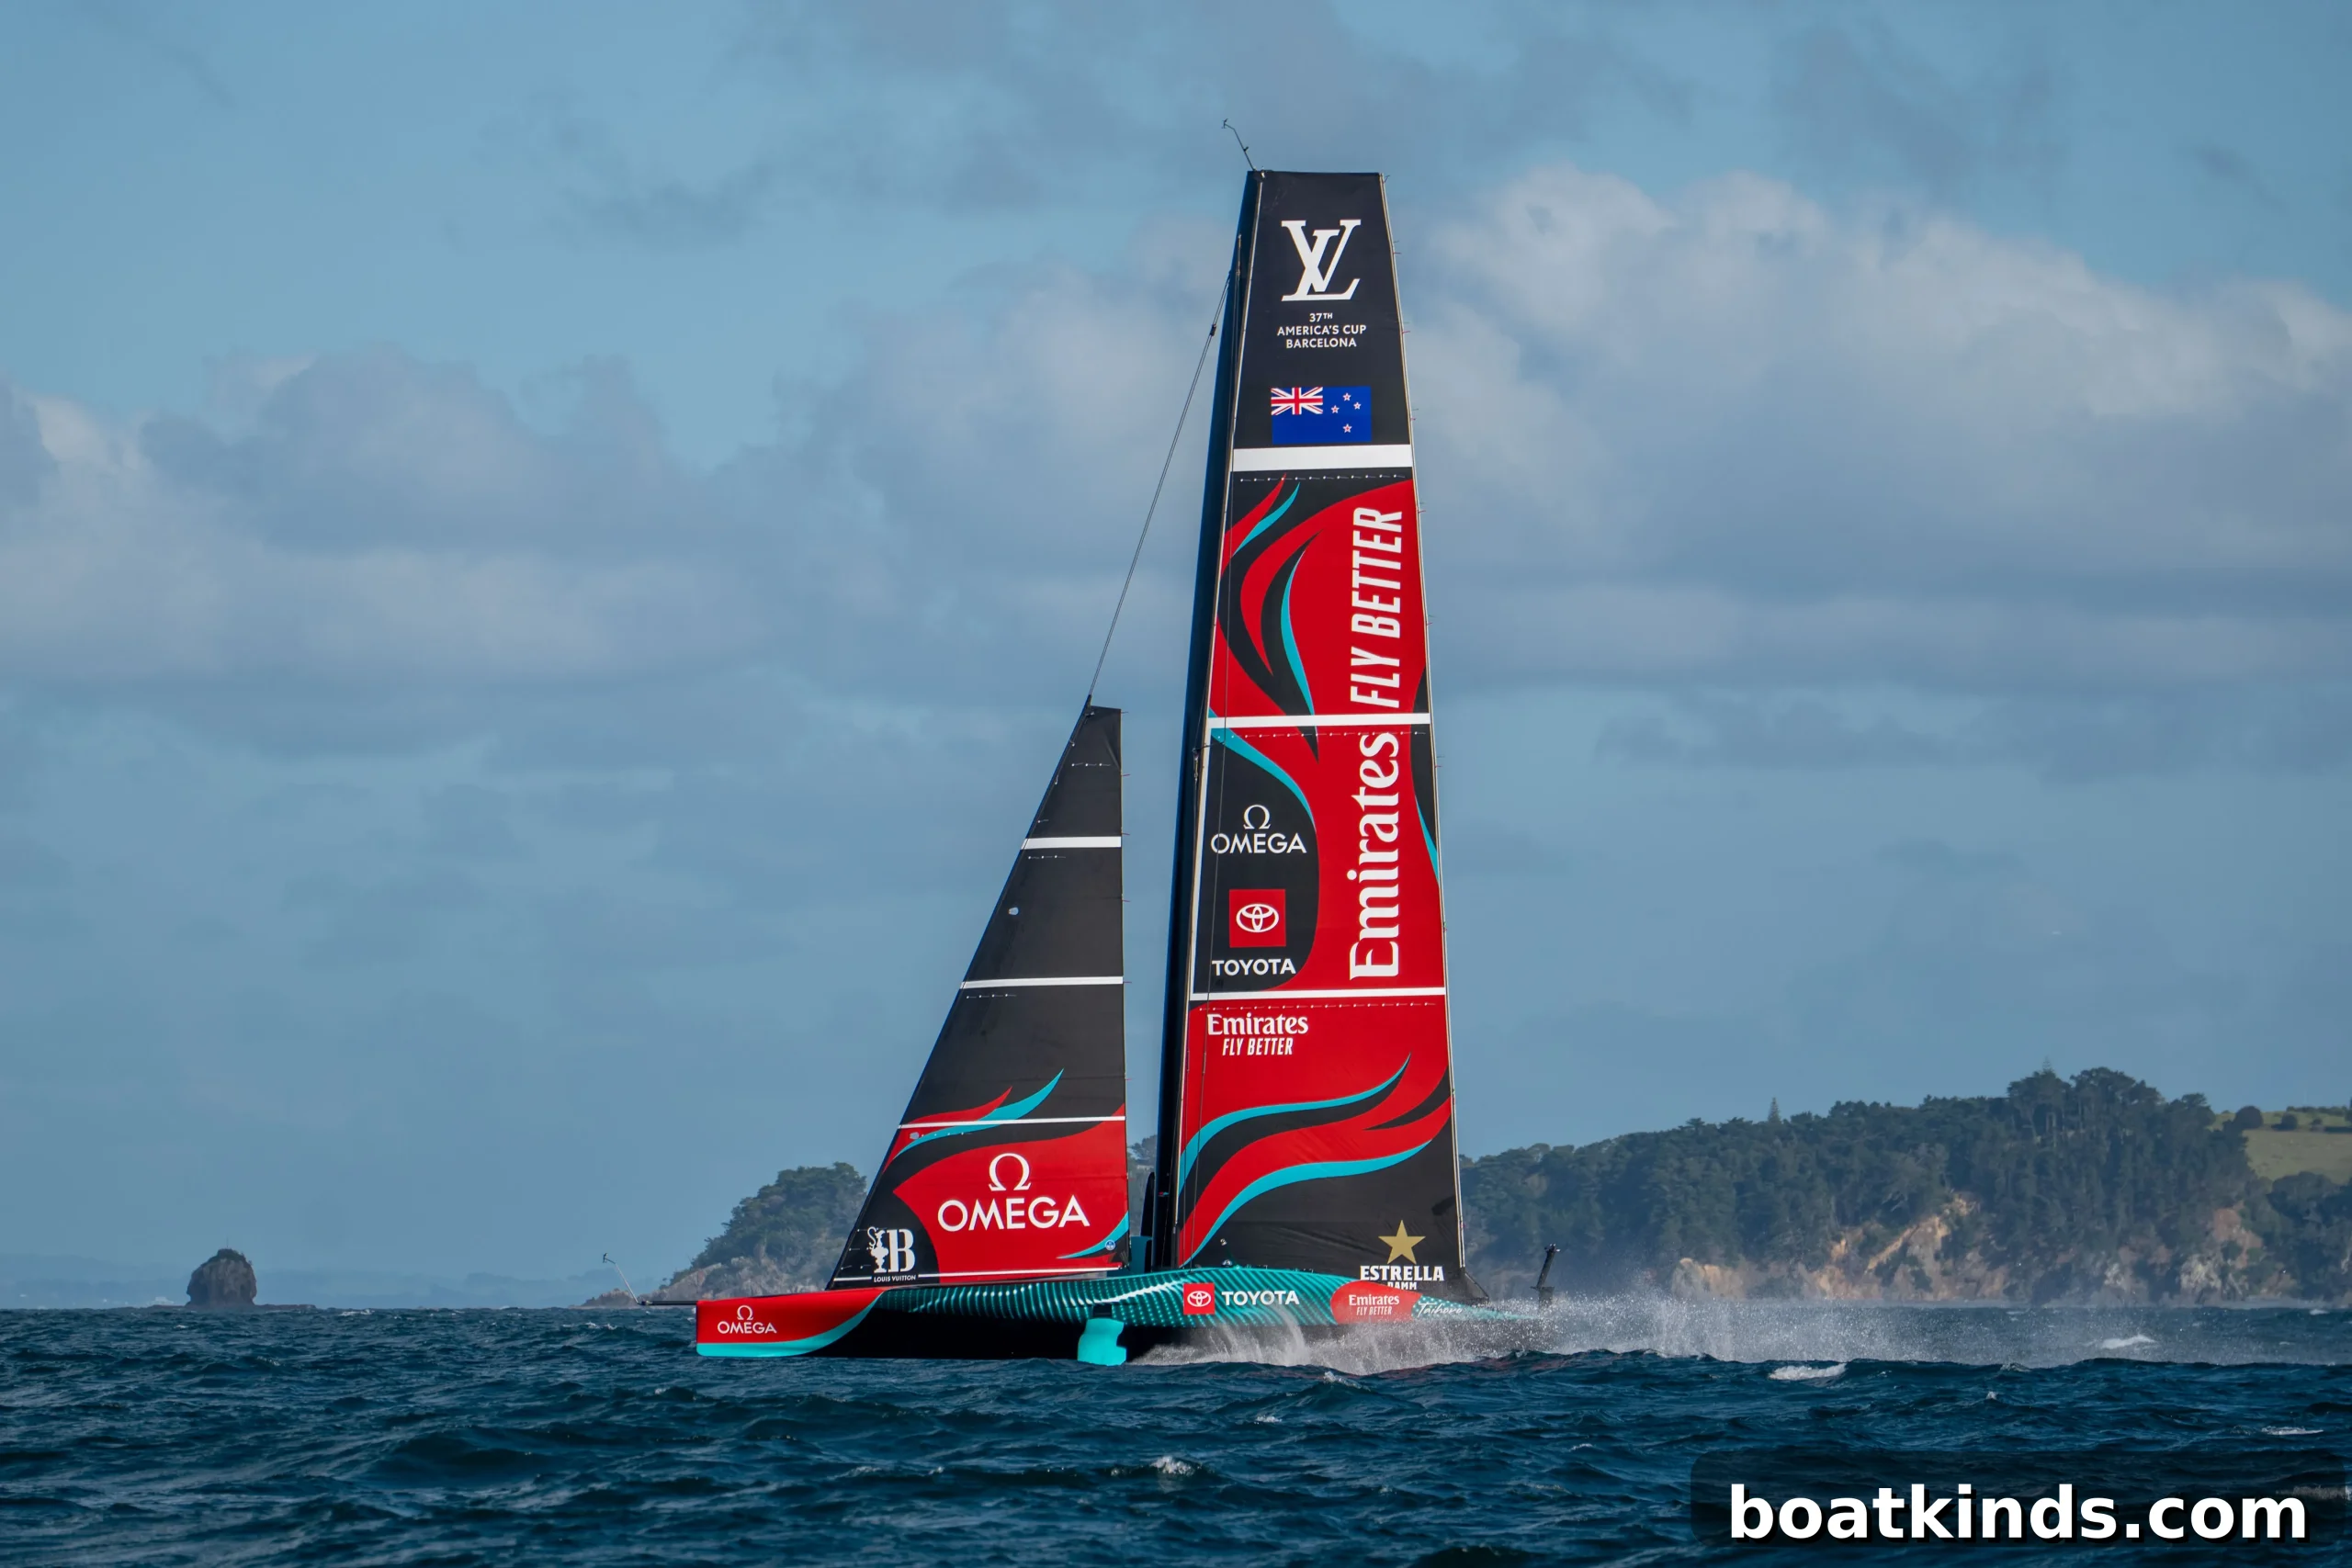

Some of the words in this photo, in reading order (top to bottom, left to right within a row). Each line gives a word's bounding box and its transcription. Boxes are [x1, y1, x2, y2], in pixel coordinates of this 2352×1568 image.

[1309, 312, 1333, 322] 37TH
[1277, 325, 1340, 336] AMERICA'S
[1342, 324, 1367, 334] CUP
[1286, 337, 1357, 348] BARCELONA
[1351, 506, 1403, 638] BETTER
[1351, 646, 1400, 708] FLY
[1210, 832, 1306, 853] OMEGA
[1347, 732, 1400, 980] Emirates
[1211, 958, 1296, 976] TOYOTA
[1207, 1011, 1308, 1035] Emirates
[1222, 1037, 1243, 1055] FLY
[1247, 1037, 1294, 1055] BETTER
[937, 1195, 1091, 1232] OMEGA
[1360, 1265, 1444, 1281] ESTRELLA
[1222, 1291, 1300, 1305] TOYOTA
[1349, 1293, 1399, 1305] Emirates
[1356, 1306, 1367, 1316] FLY
[1369, 1305, 1392, 1315] BETTER
[717, 1320, 777, 1335] OMEGA
